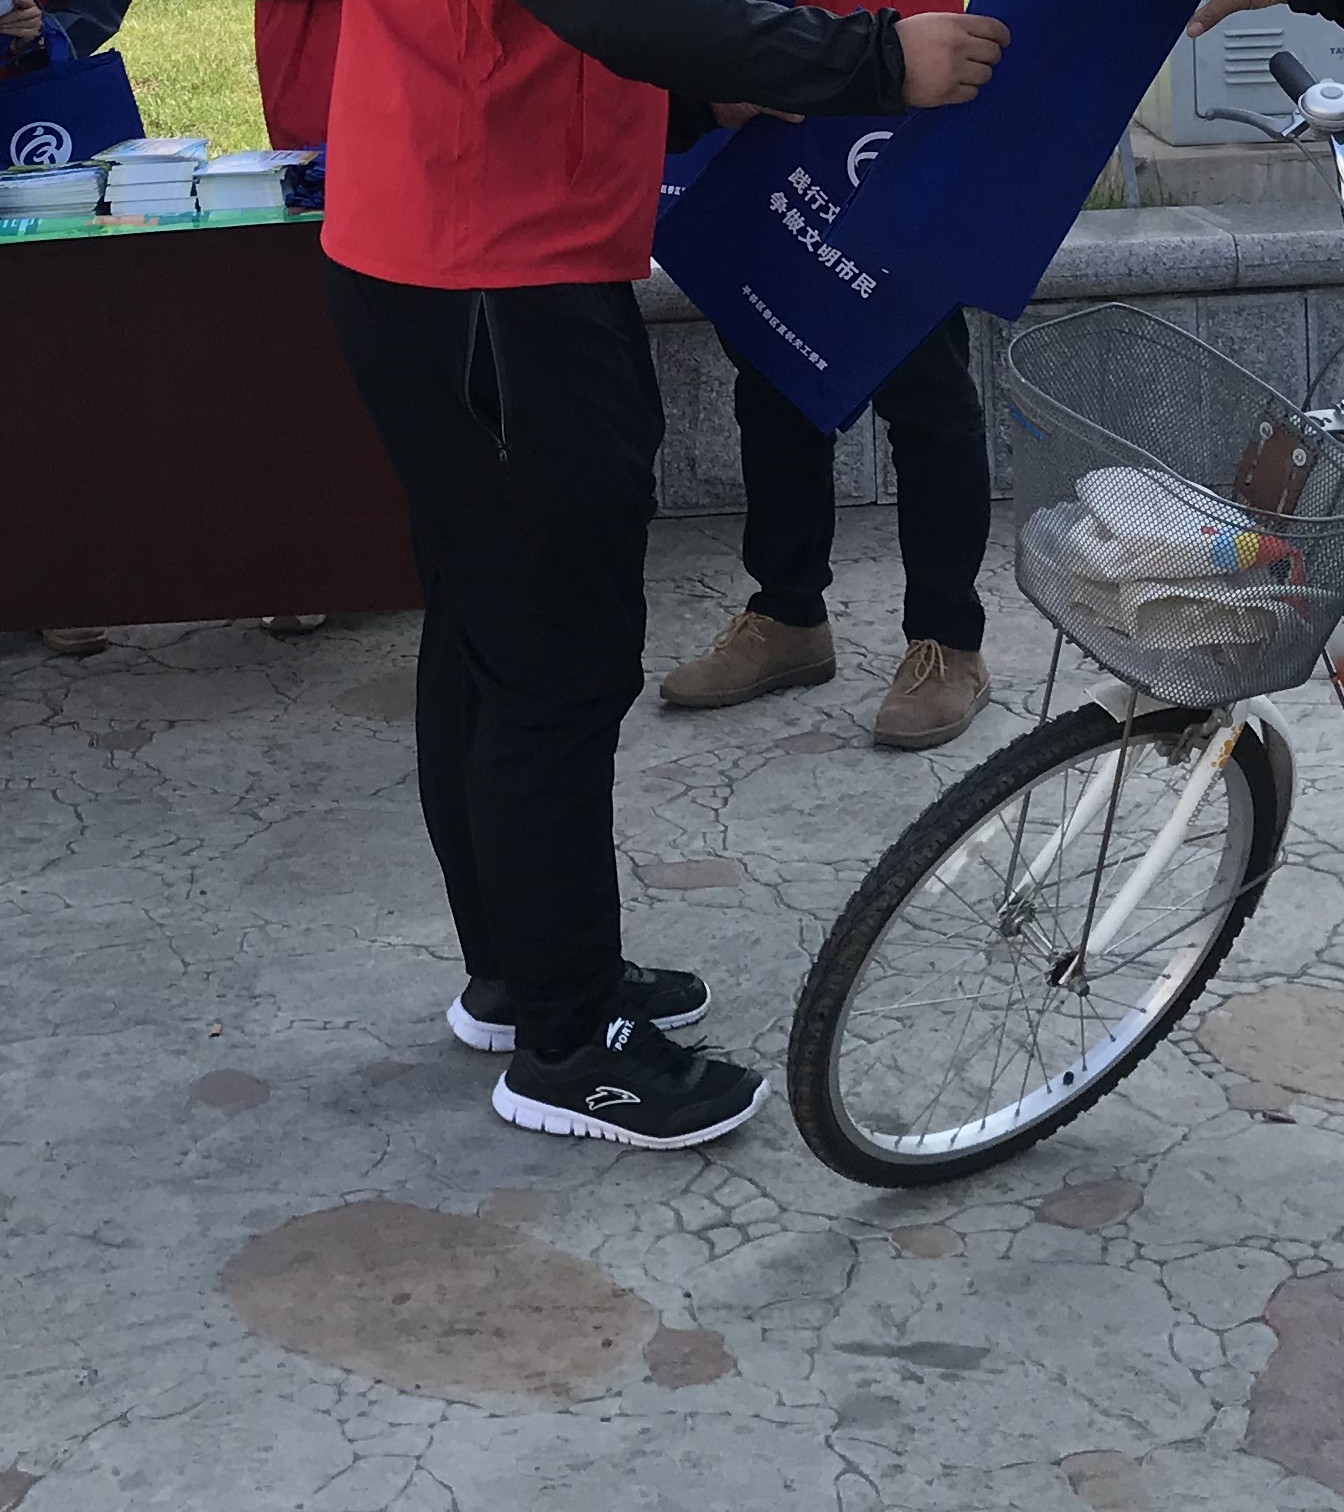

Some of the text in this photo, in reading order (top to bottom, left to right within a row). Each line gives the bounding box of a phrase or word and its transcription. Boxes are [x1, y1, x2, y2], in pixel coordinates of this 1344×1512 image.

[769, 191, 877, 299] 争做文明市民
